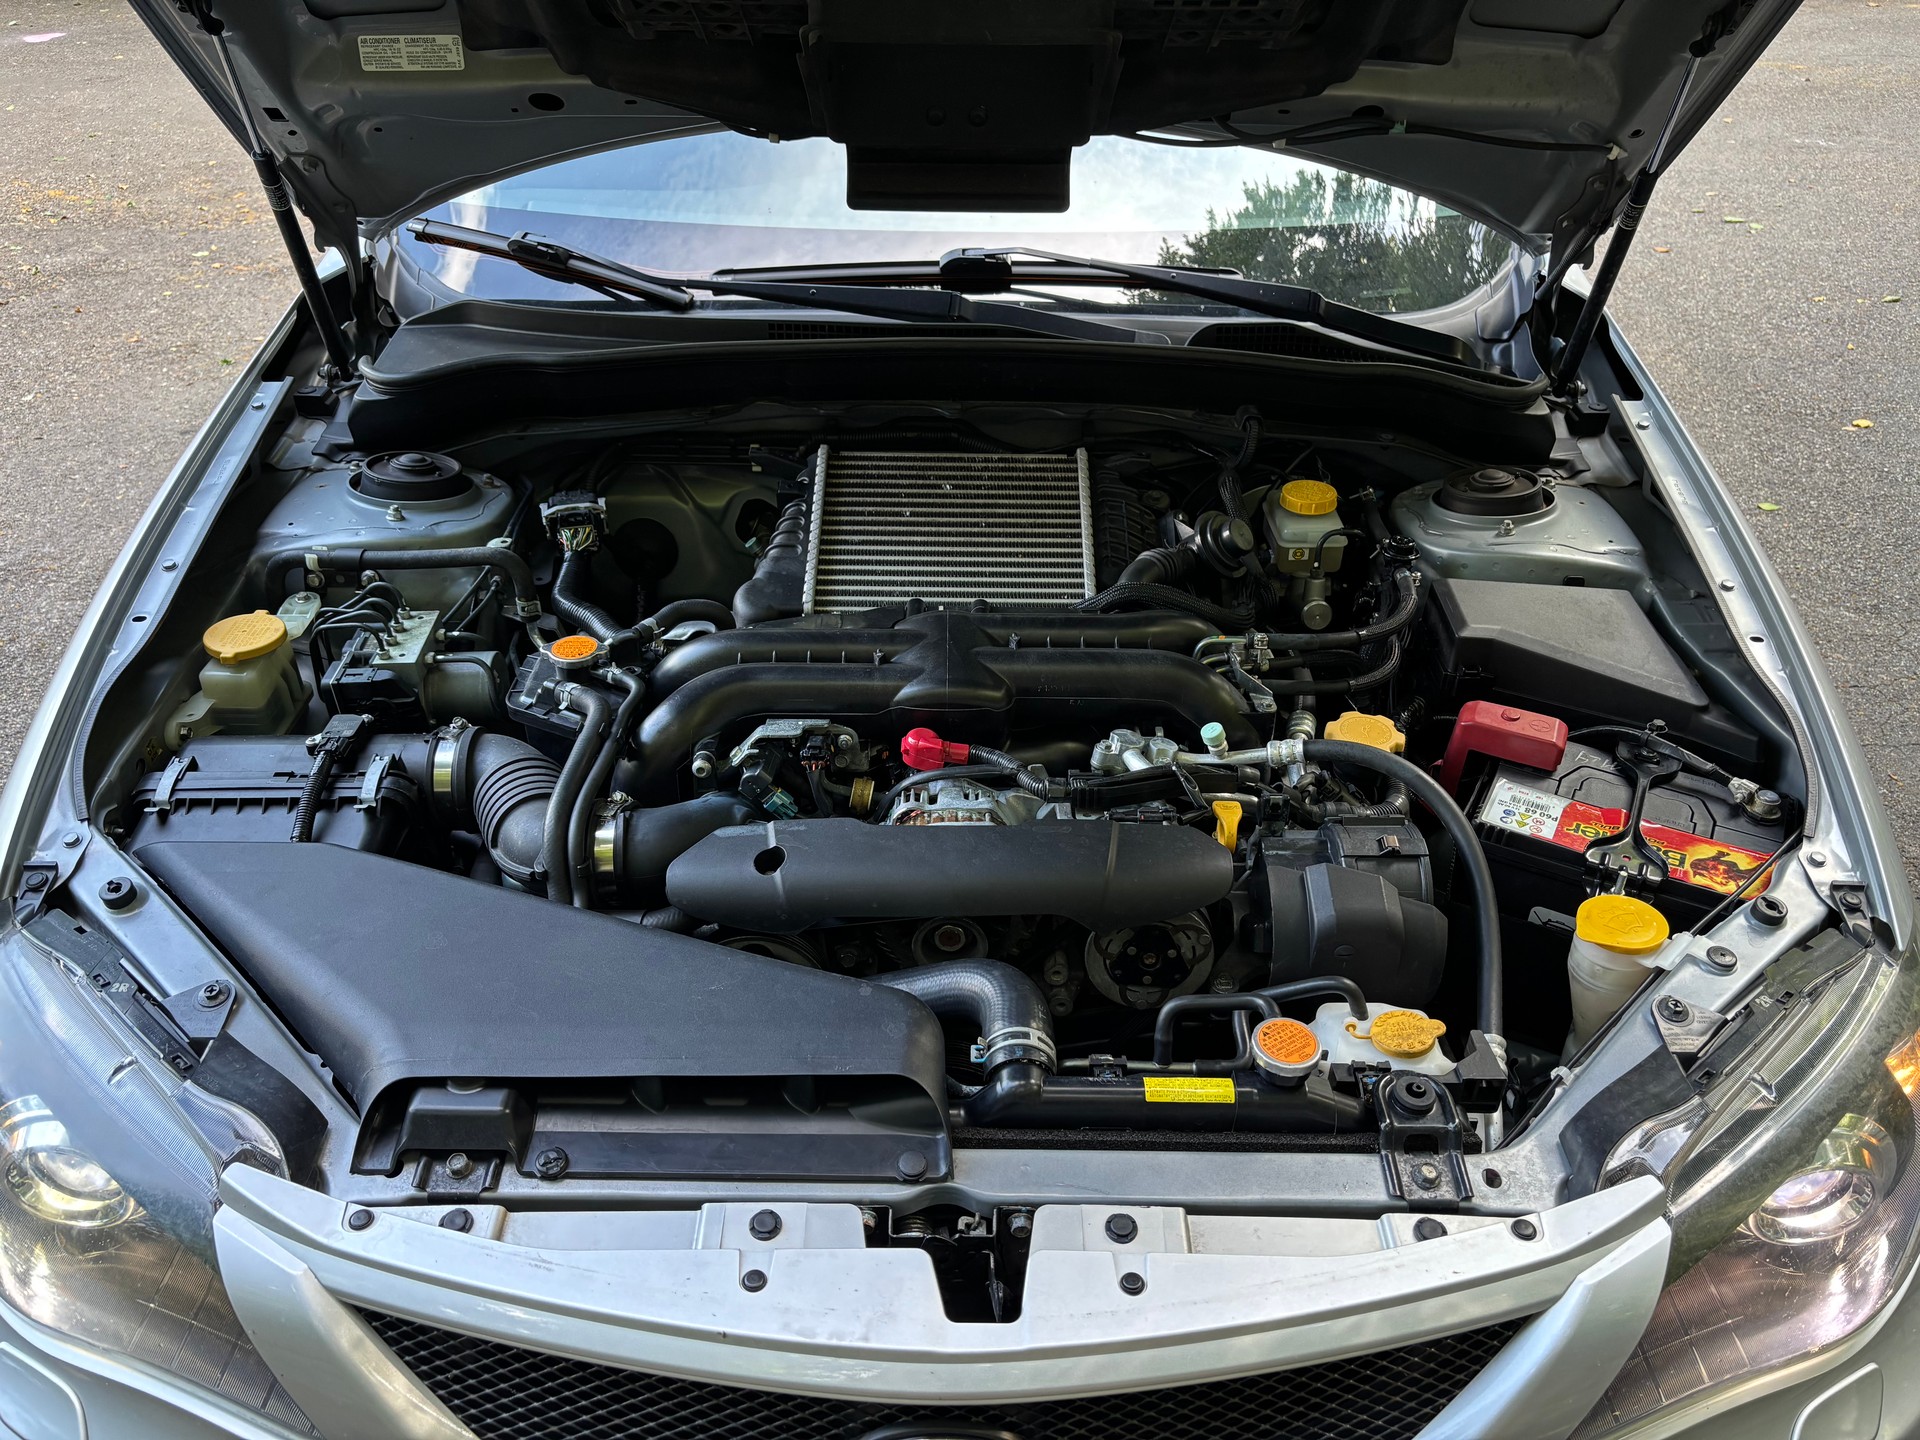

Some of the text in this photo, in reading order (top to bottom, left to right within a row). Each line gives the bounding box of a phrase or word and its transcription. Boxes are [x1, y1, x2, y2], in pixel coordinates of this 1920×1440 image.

[1524, 807, 1559, 823] P60 68
[110, 982, 129, 992] 2R
